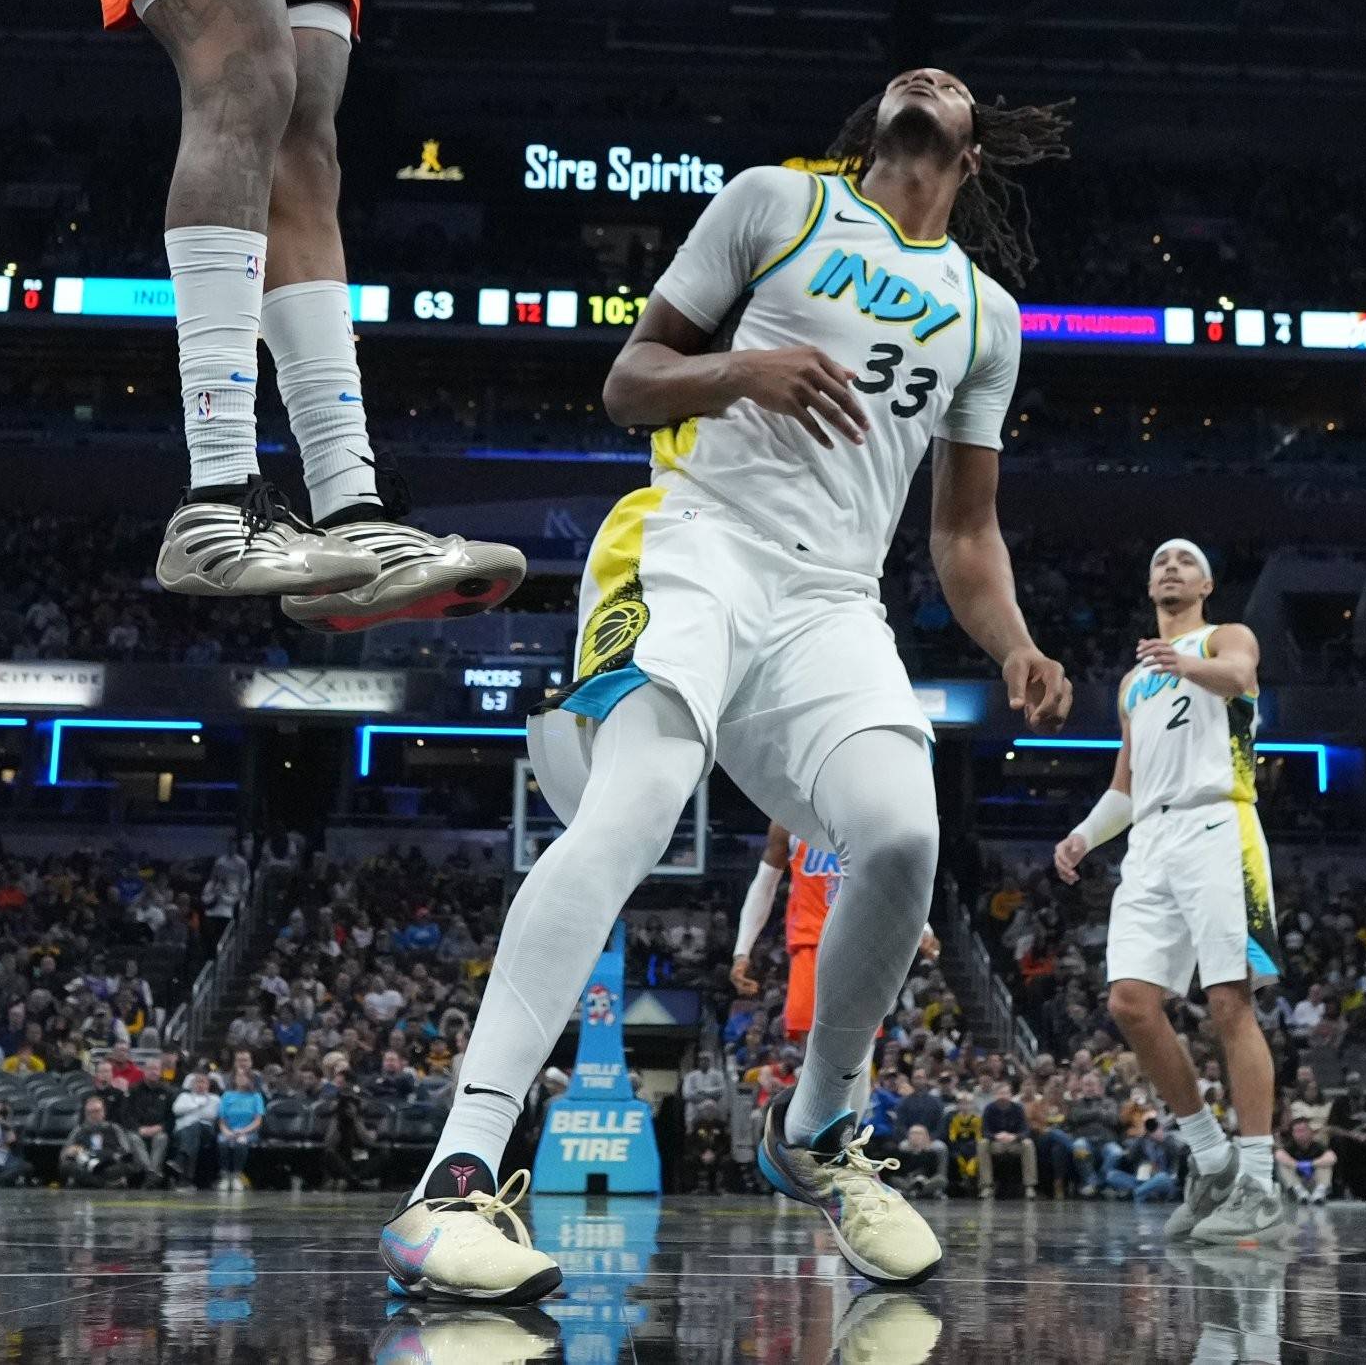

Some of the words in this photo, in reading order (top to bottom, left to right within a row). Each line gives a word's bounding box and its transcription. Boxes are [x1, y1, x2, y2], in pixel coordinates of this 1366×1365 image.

[524, 144, 597, 190] Sire
[607, 146, 725, 201] Spirits
[24, 289, 40, 310] 0
[414, 290, 454, 320] 63
[803, 248, 962, 348] INDY
[516, 302, 543, 324] 12
[851, 342, 938, 419] 33
[464, 668, 522, 688] PACERS
[481, 691, 508, 711] 63
[1166, 695, 1192, 731] 2
[550, 1110, 645, 1135] BELLE
[559, 1137, 631, 1163] TIRE
